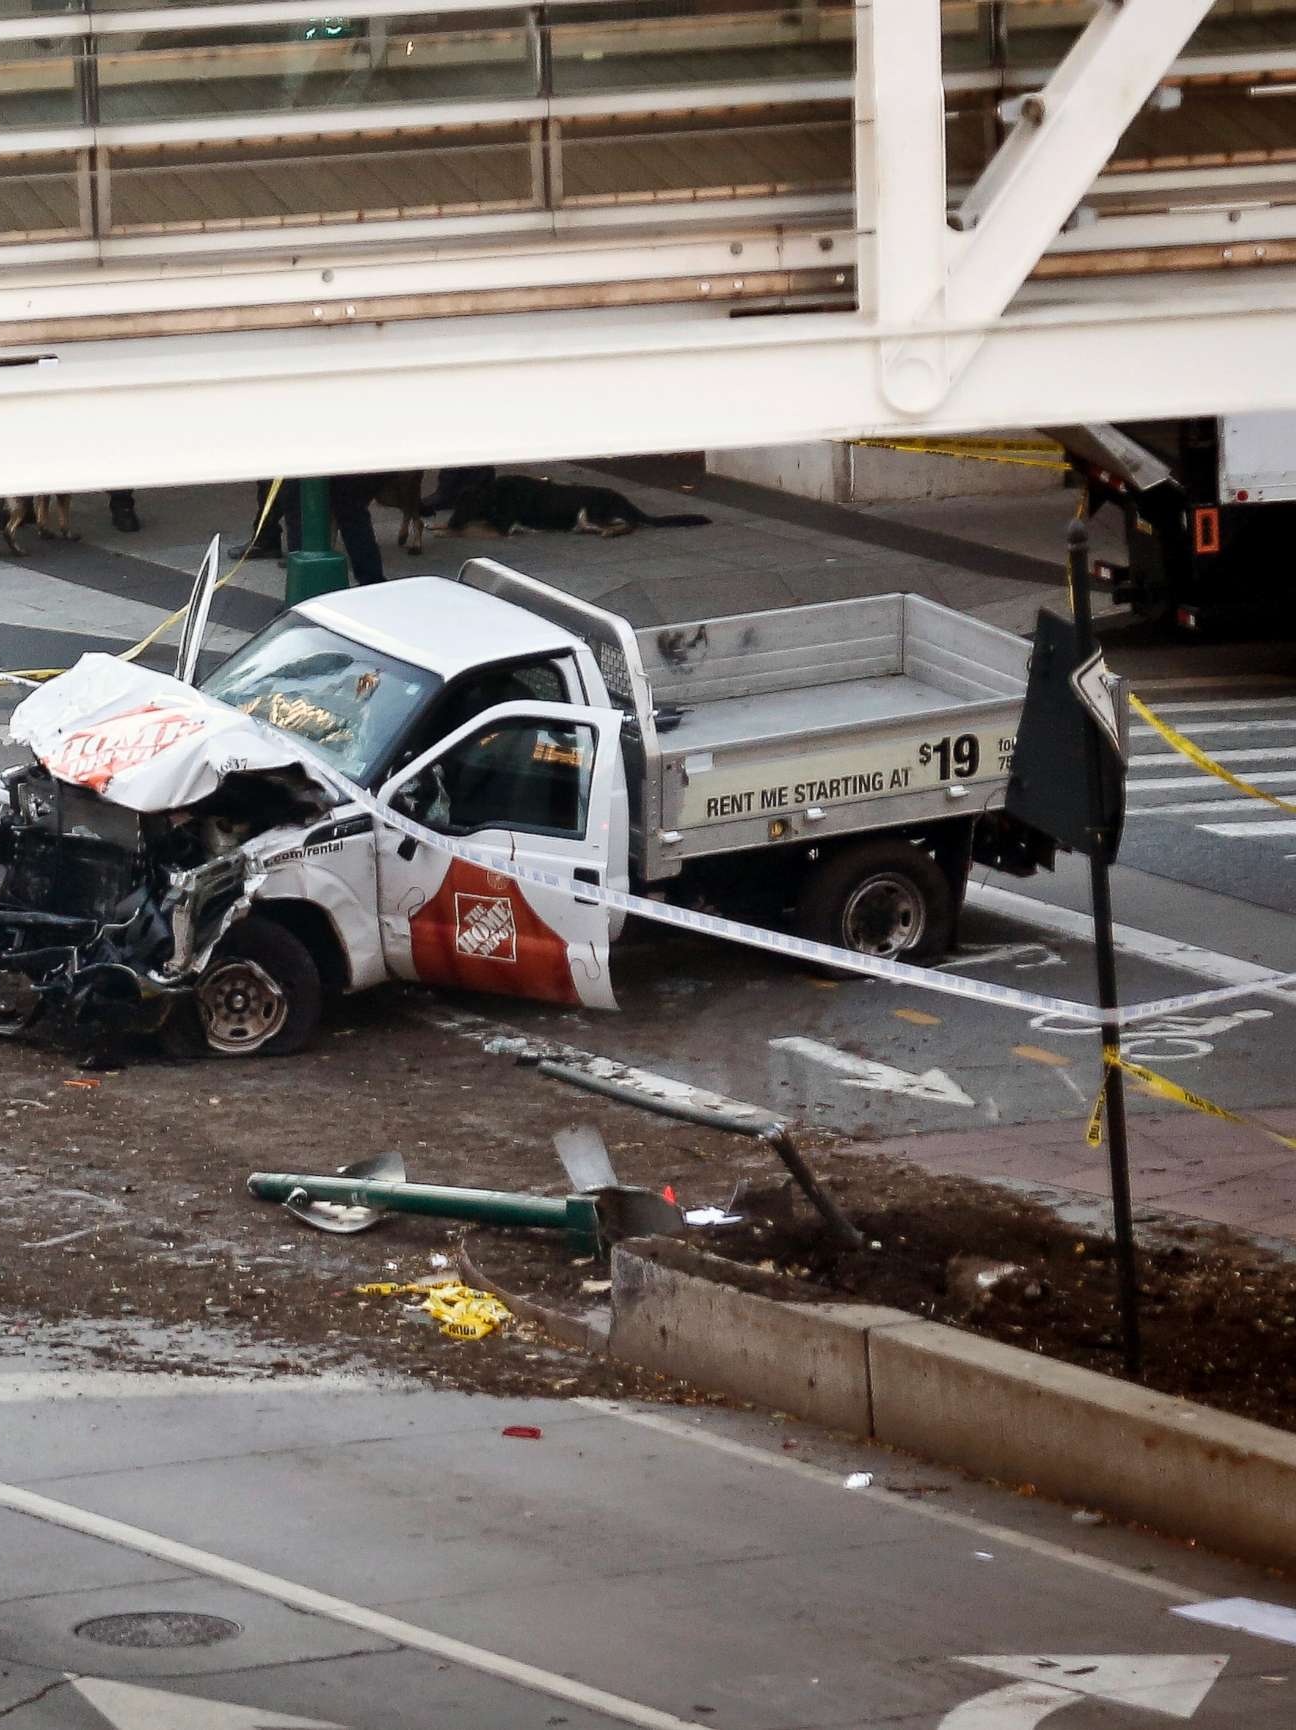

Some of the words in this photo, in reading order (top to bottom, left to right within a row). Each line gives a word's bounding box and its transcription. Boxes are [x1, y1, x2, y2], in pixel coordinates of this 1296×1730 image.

[707, 791, 755, 818] RENT
[761, 786, 788, 808] ME
[794, 772, 884, 803] STARTING
[890, 767, 912, 790] AT
[918, 733, 980, 781] $19
[458, 900, 512, 954] HOME
[464, 902, 487, 926] THE
[478, 921, 515, 956] DEPOT
